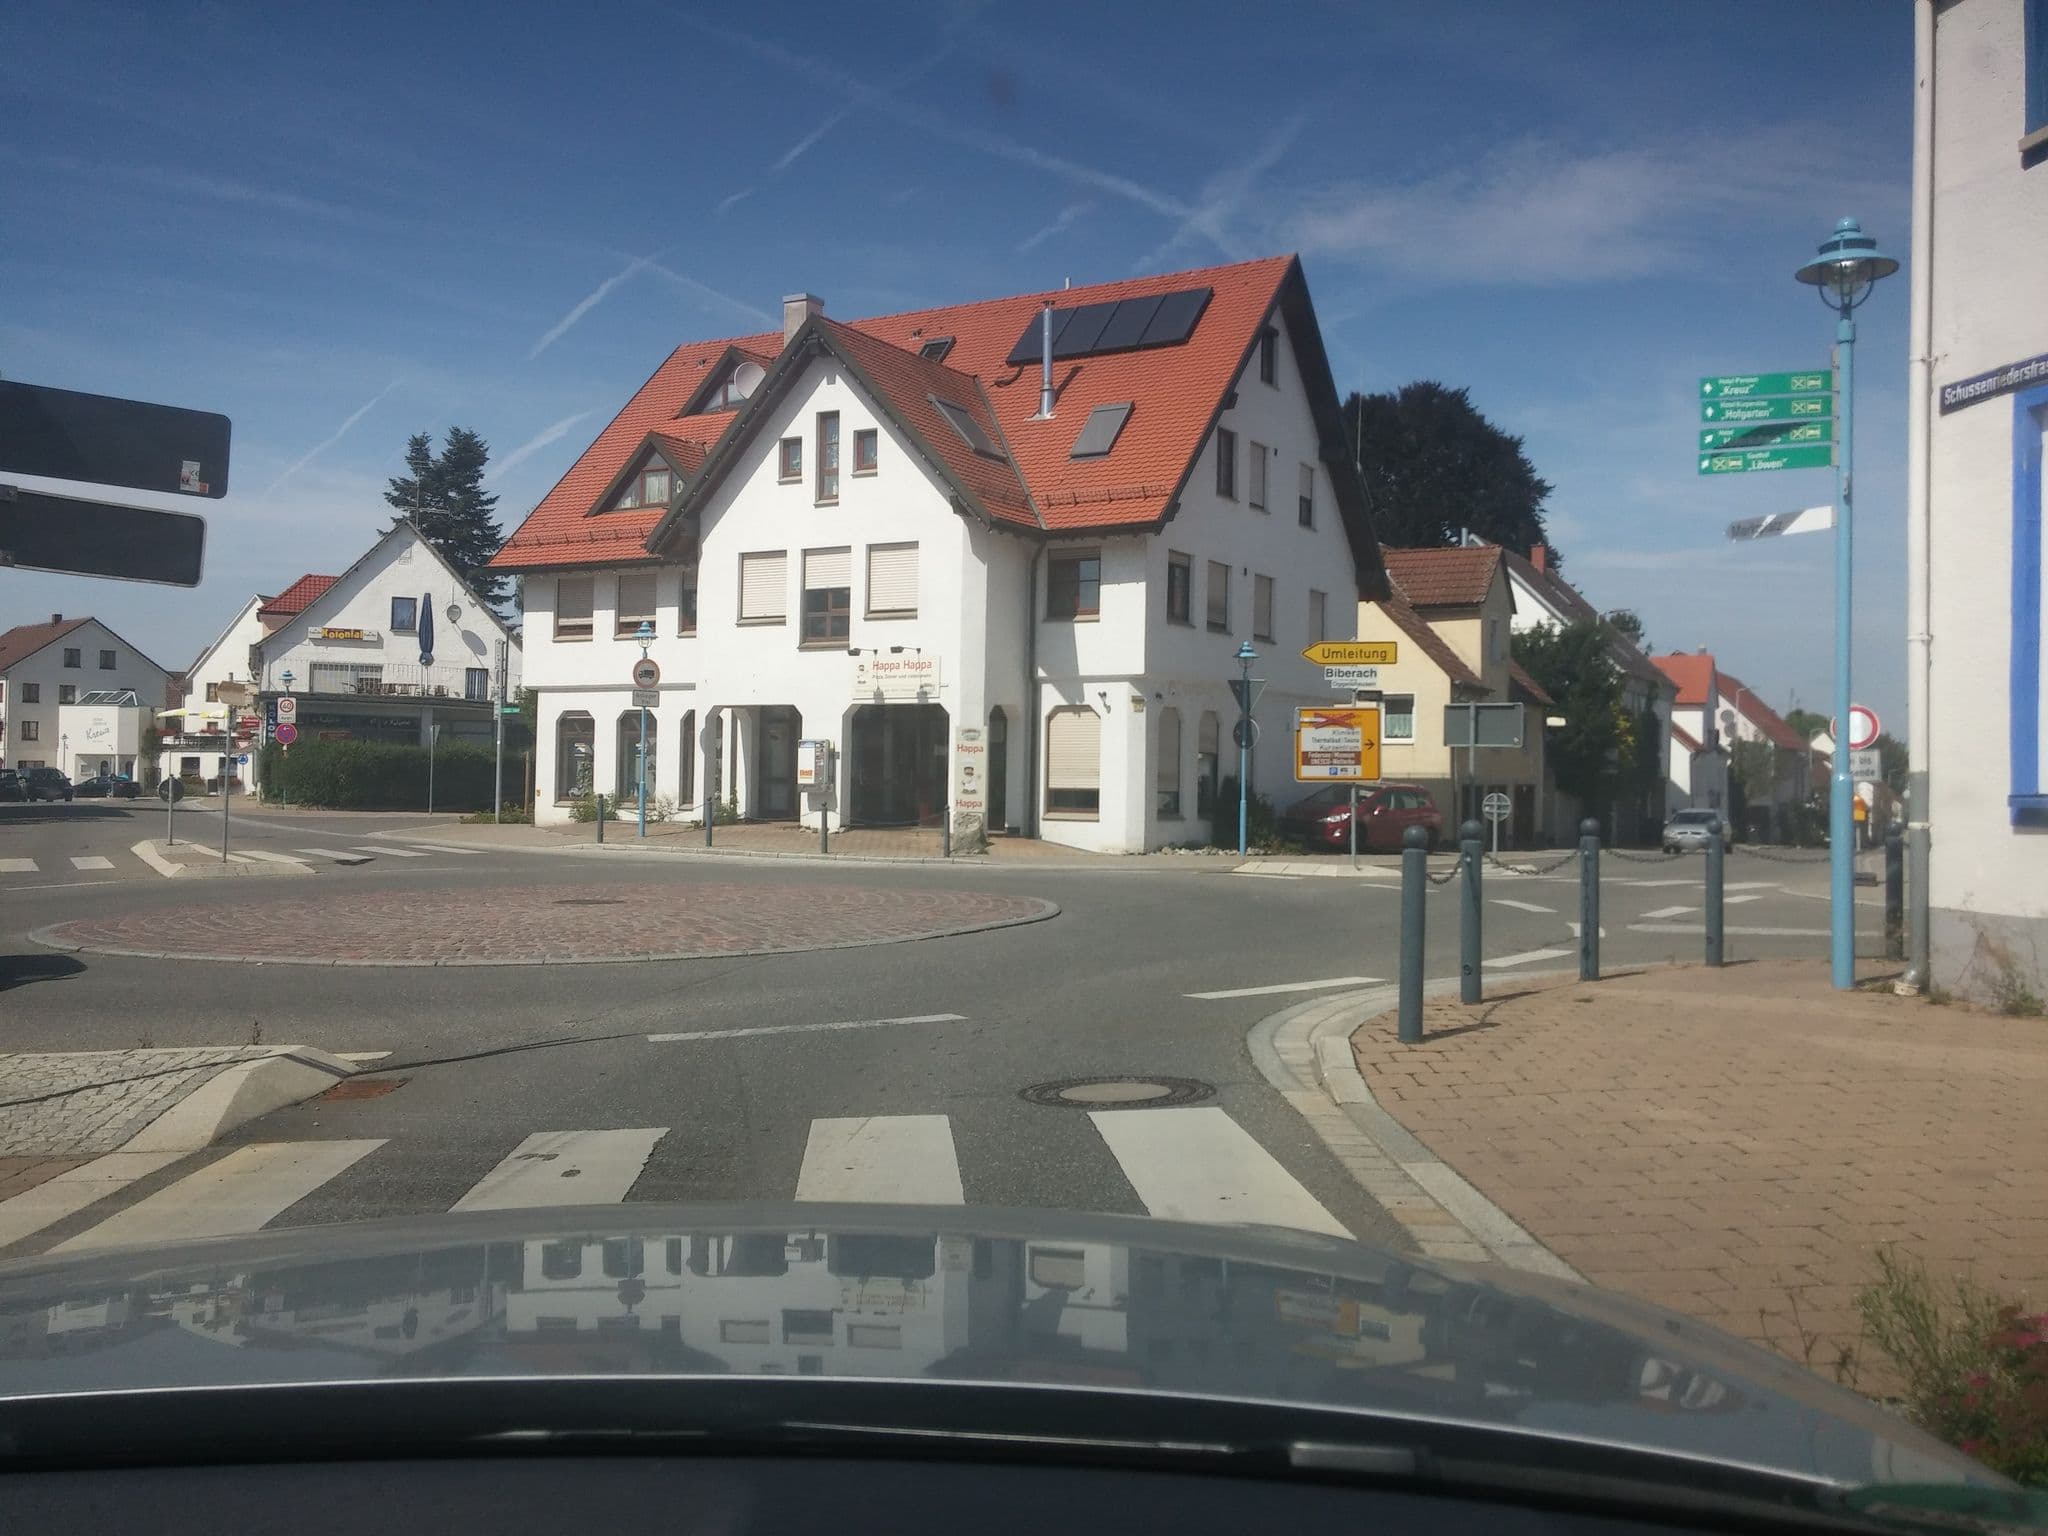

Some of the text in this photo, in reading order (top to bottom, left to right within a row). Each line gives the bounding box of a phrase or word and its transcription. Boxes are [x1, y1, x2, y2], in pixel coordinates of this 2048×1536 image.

[1321, 647, 1387, 661] Umleitung
[872, 659, 932, 672] Happa Happa
[1325, 668, 1378, 678] Biberach
[957, 744, 984, 753] Happa
[955, 800, 983, 808] Happa
